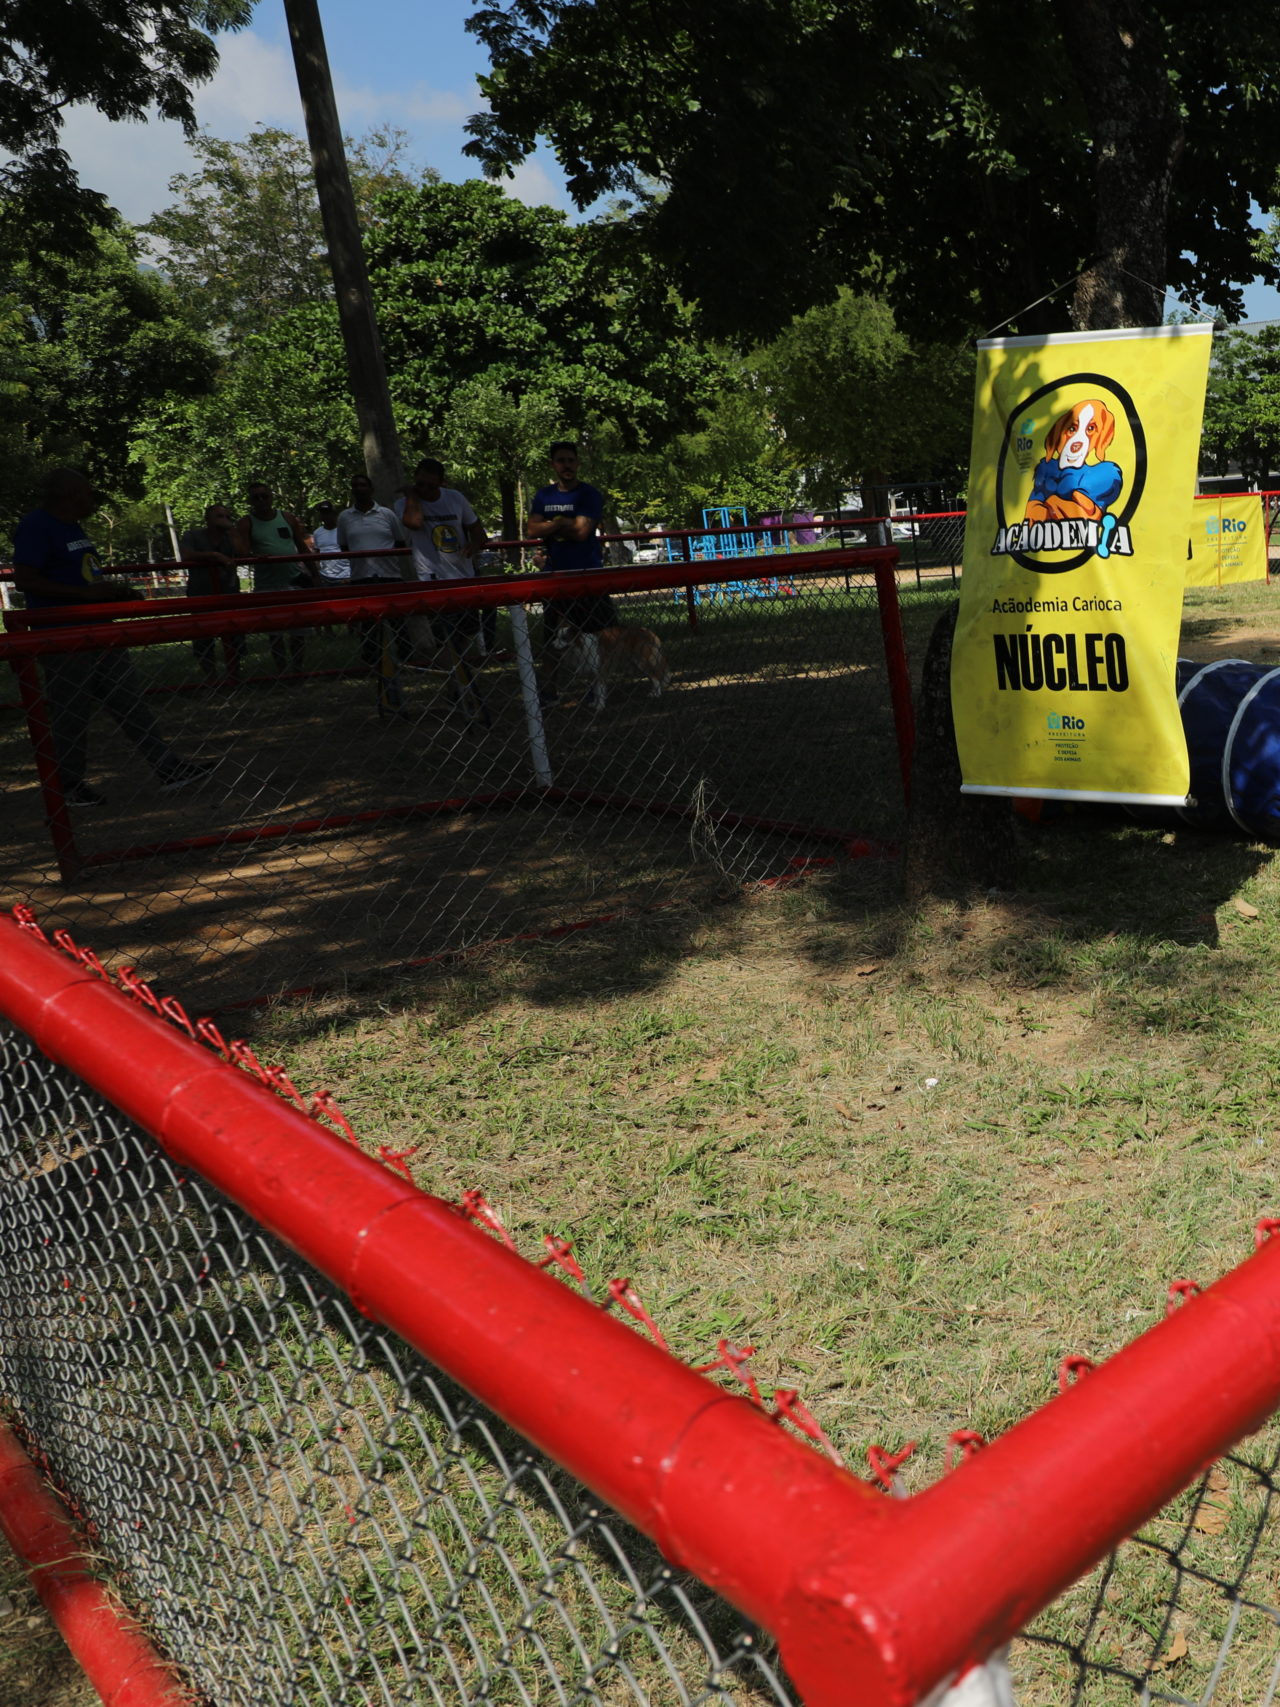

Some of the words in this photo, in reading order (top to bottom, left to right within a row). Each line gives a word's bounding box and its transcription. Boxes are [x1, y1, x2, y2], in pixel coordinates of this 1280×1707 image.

[1017, 437, 1034, 451] Rio
[1221, 518, 1247, 533] Rio
[992, 597, 1068, 614] Acãodemia
[1072, 595, 1122, 611] Carioca
[993, 624, 1129, 693] NÚCLEO
[1062, 715, 1085, 730] Rio
